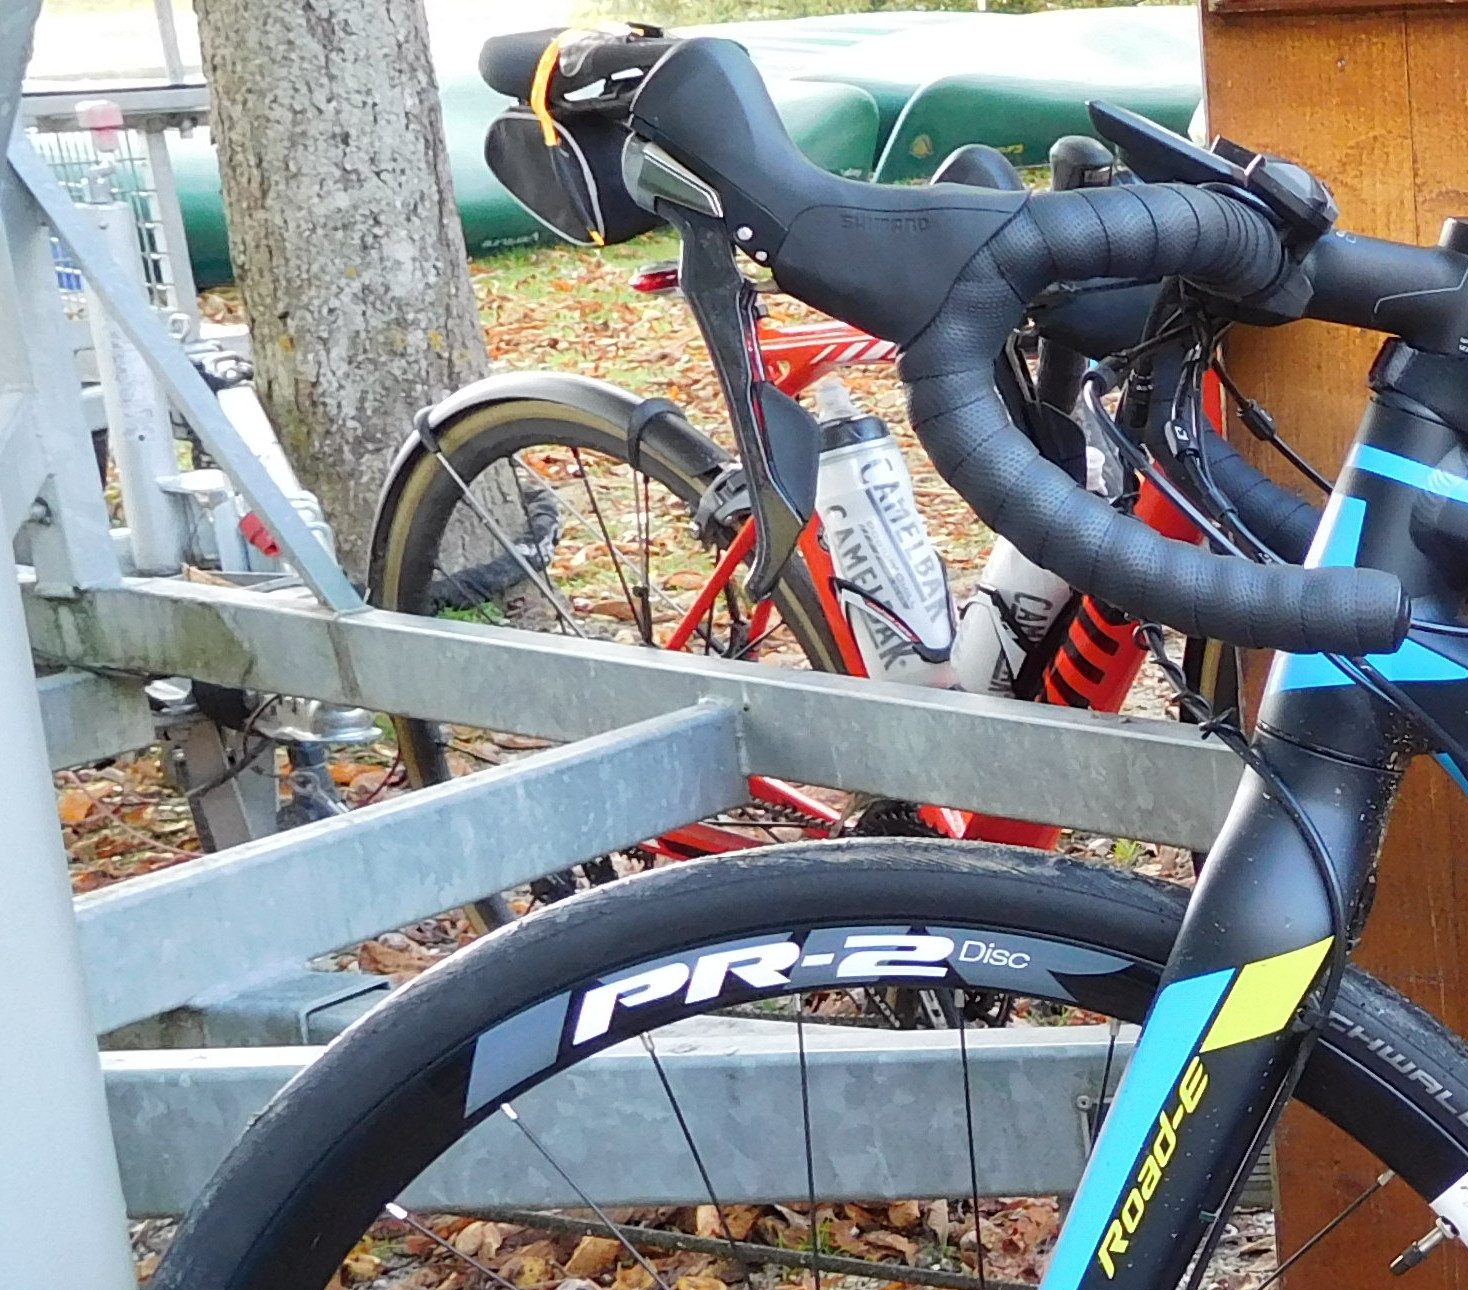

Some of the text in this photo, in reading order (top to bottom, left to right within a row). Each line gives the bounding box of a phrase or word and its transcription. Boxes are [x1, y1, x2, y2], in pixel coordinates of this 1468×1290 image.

[860, 457, 951, 624] CAMELBAK
[572, 934, 1030, 1046] PR-2 Disc
[1098, 1056, 1209, 1280] Road-E
